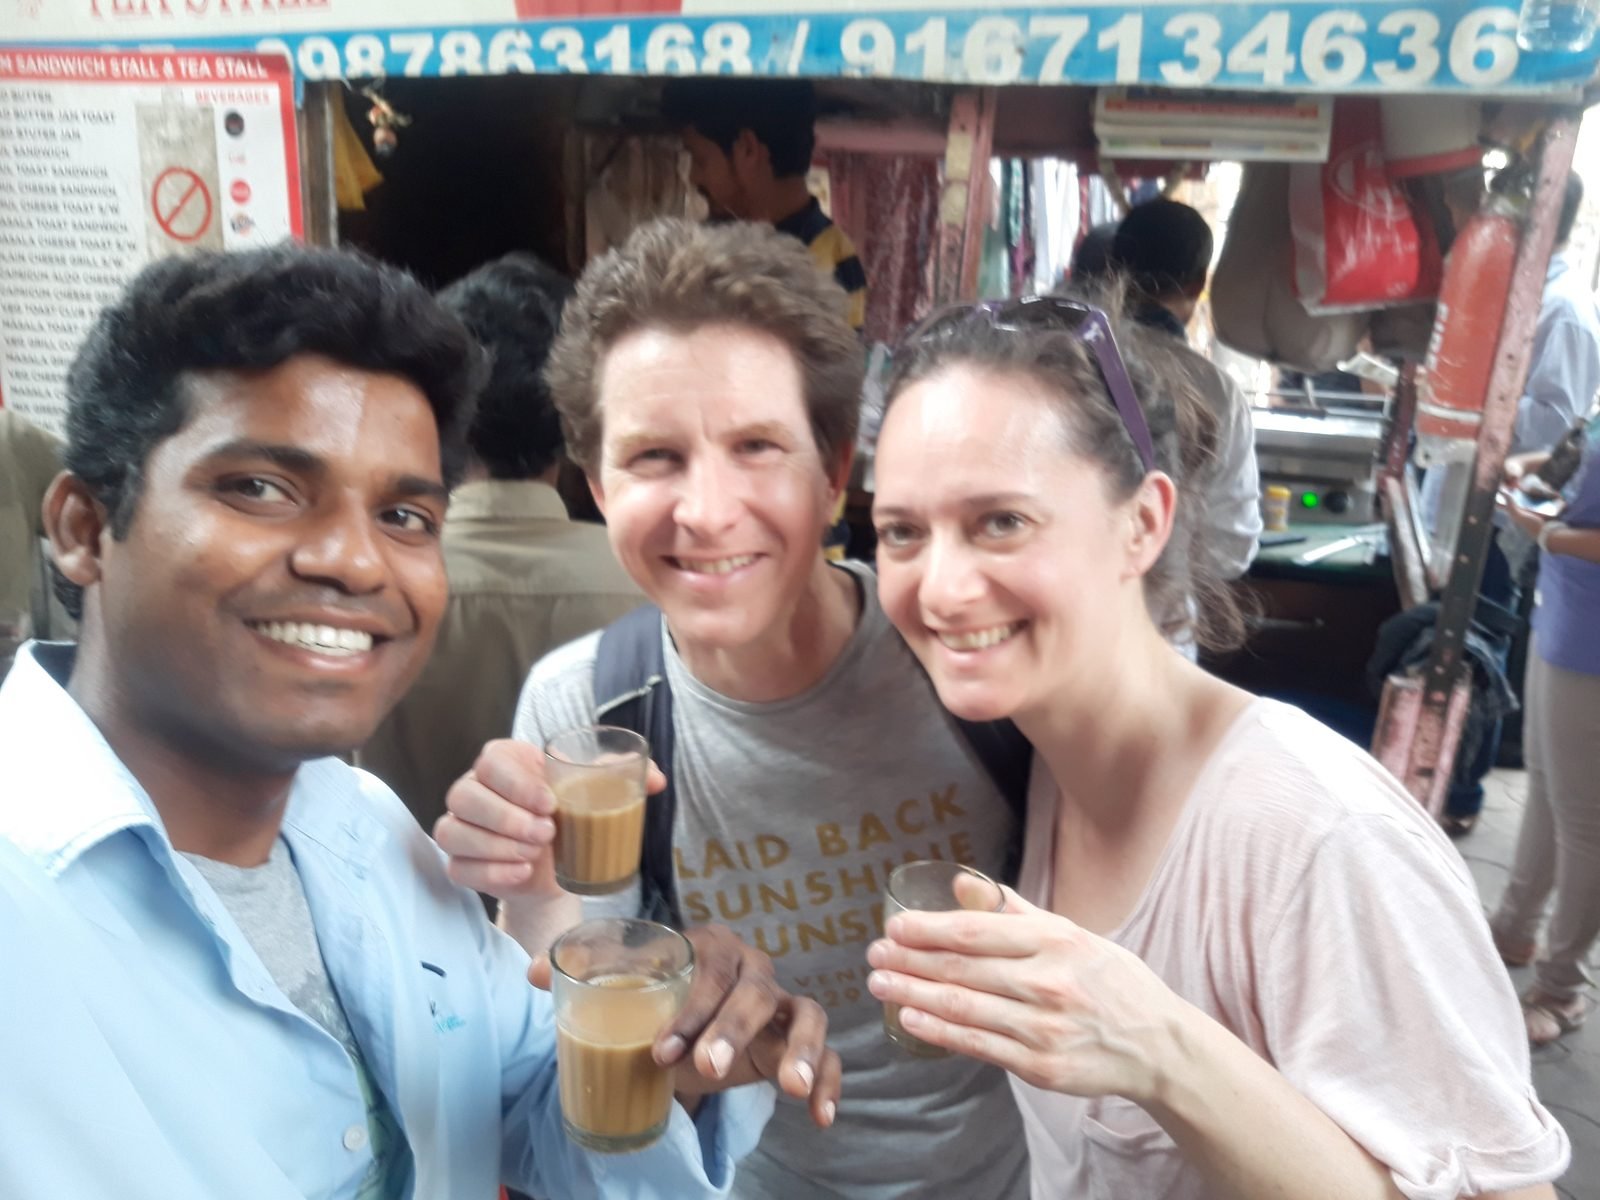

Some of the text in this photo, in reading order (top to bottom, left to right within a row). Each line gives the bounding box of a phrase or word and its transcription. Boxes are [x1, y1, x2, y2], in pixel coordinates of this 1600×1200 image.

[15, 54, 106, 77] SANDWICH
[110, 56, 161, 79] STALL
[178, 57, 211, 79] TEA
[215, 57, 269, 80] STALL
[839, 7, 1520, 86] 9167134636
[194, 89, 270, 105] BEVERAGES
[672, 782, 968, 881] LAID BACK
